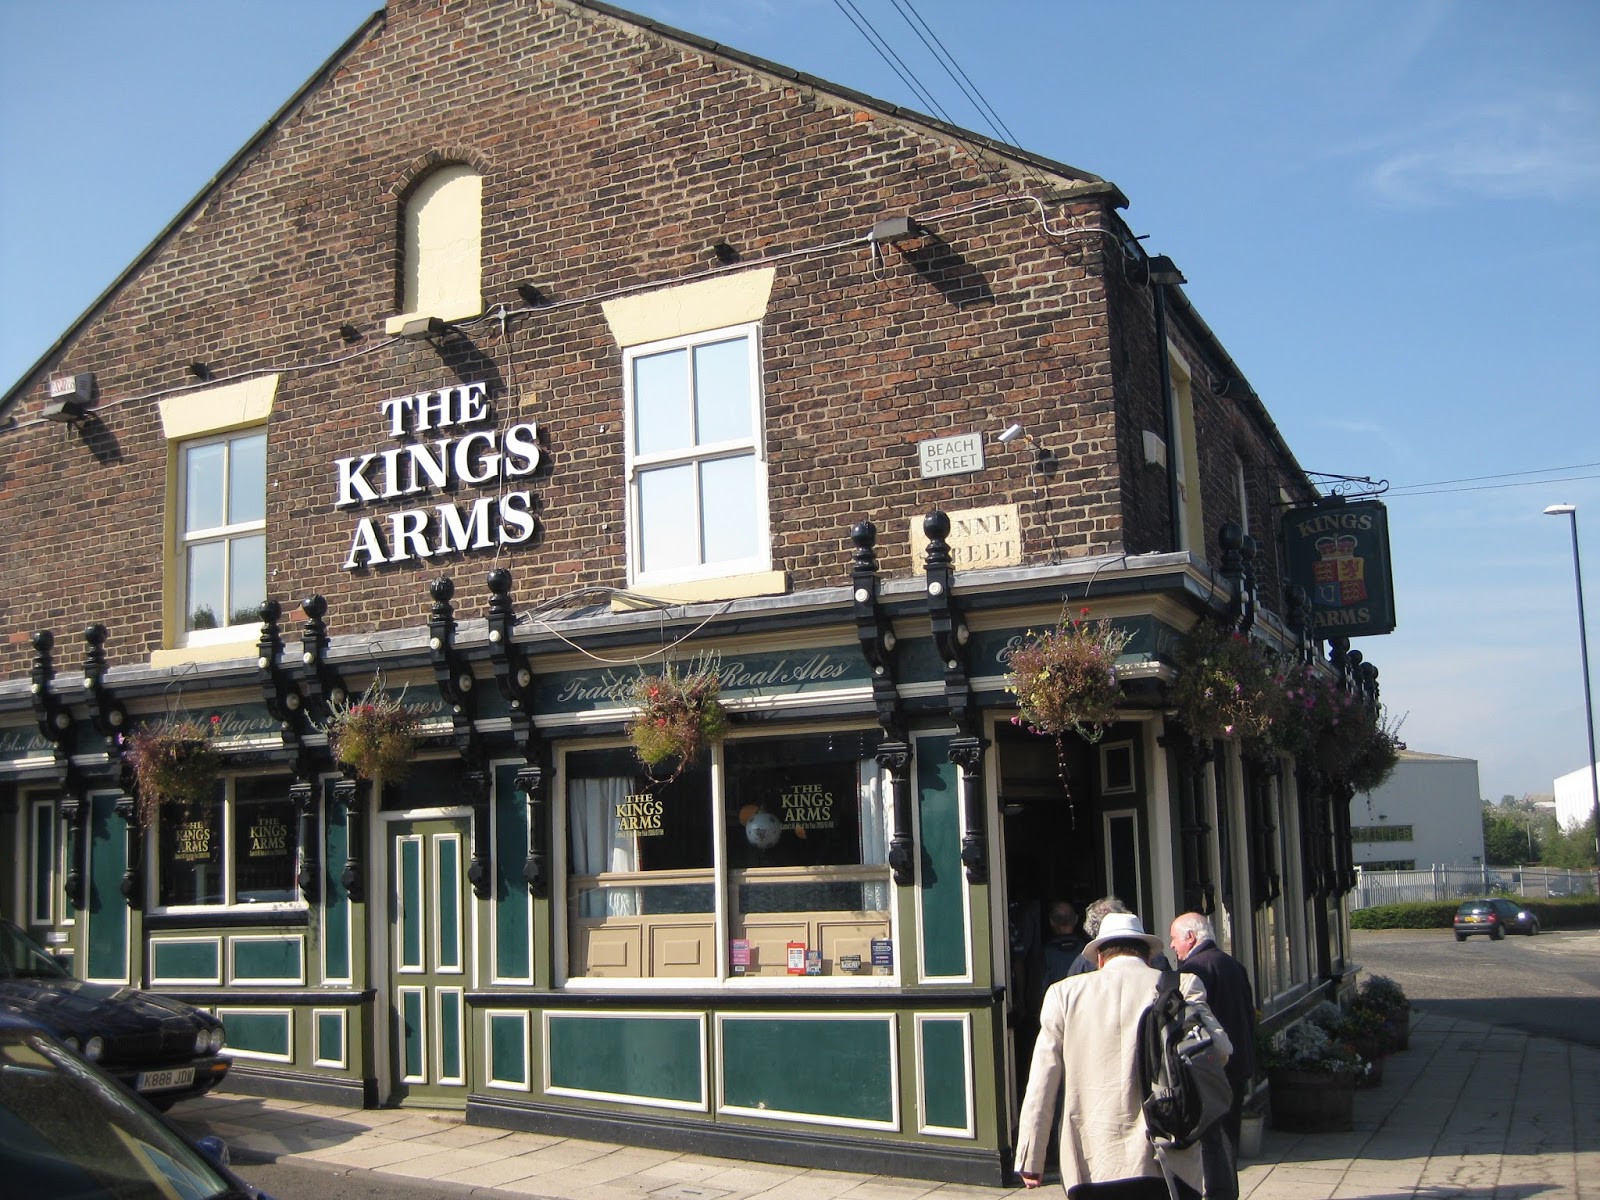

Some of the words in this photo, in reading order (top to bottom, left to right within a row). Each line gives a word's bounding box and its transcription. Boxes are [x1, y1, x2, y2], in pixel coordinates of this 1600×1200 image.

[382, 382, 487, 436] THE
[927, 439, 974, 457] BEACH
[335, 422, 540, 505] KINGS
[925, 453, 977, 473] STREET
[343, 491, 535, 568] ARMS
[950, 514, 1010, 537] NNE
[1296, 513, 1372, 537] KINGS
[919, 541, 1015, 564] REET
[1313, 607, 1370, 627] ARMS
[718, 659, 784, 687] Real
[781, 654, 851, 683] Ales
[217, 711, 277, 740] Lagers
[624, 793, 654, 803] THE
[791, 784, 822, 793] THE
[615, 801, 663, 817] KINGS
[781, 792, 833, 808] KINGS
[619, 815, 661, 830] ARMS
[785, 806, 831, 821] ARMS
[250, 825, 287, 838] KINGS
[252, 836, 285, 850] ARMS
